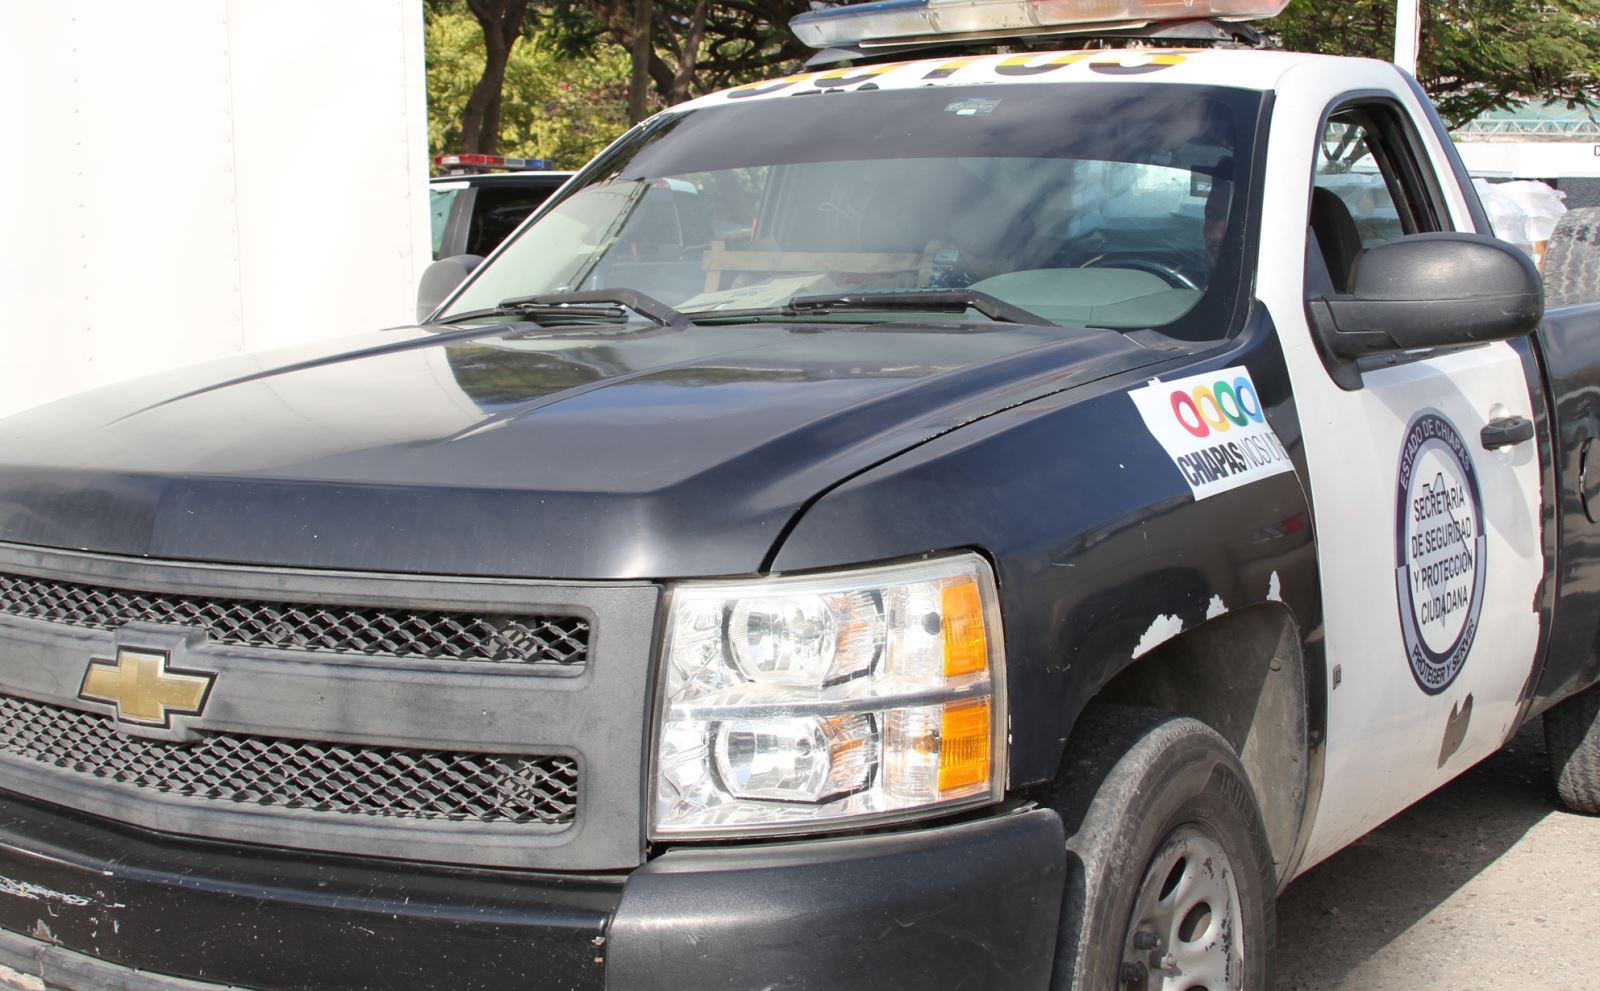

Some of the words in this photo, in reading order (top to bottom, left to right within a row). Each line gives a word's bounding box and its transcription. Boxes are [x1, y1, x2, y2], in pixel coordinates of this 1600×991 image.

[1400, 426, 1423, 490] ESTADO
[1422, 418, 1435, 437] DE
[1435, 421, 1471, 471] CHIAPAS
[1411, 533, 1424, 559] DE
[1425, 516, 1472, 554] SEGURIDAD
[1413, 570, 1420, 593] Y
[1421, 585, 1468, 626] CIUDADANA
[1412, 643, 1446, 685] PROTEGER
[1446, 662, 1452, 677] Y
[1452, 618, 1475, 672] SERVIR
